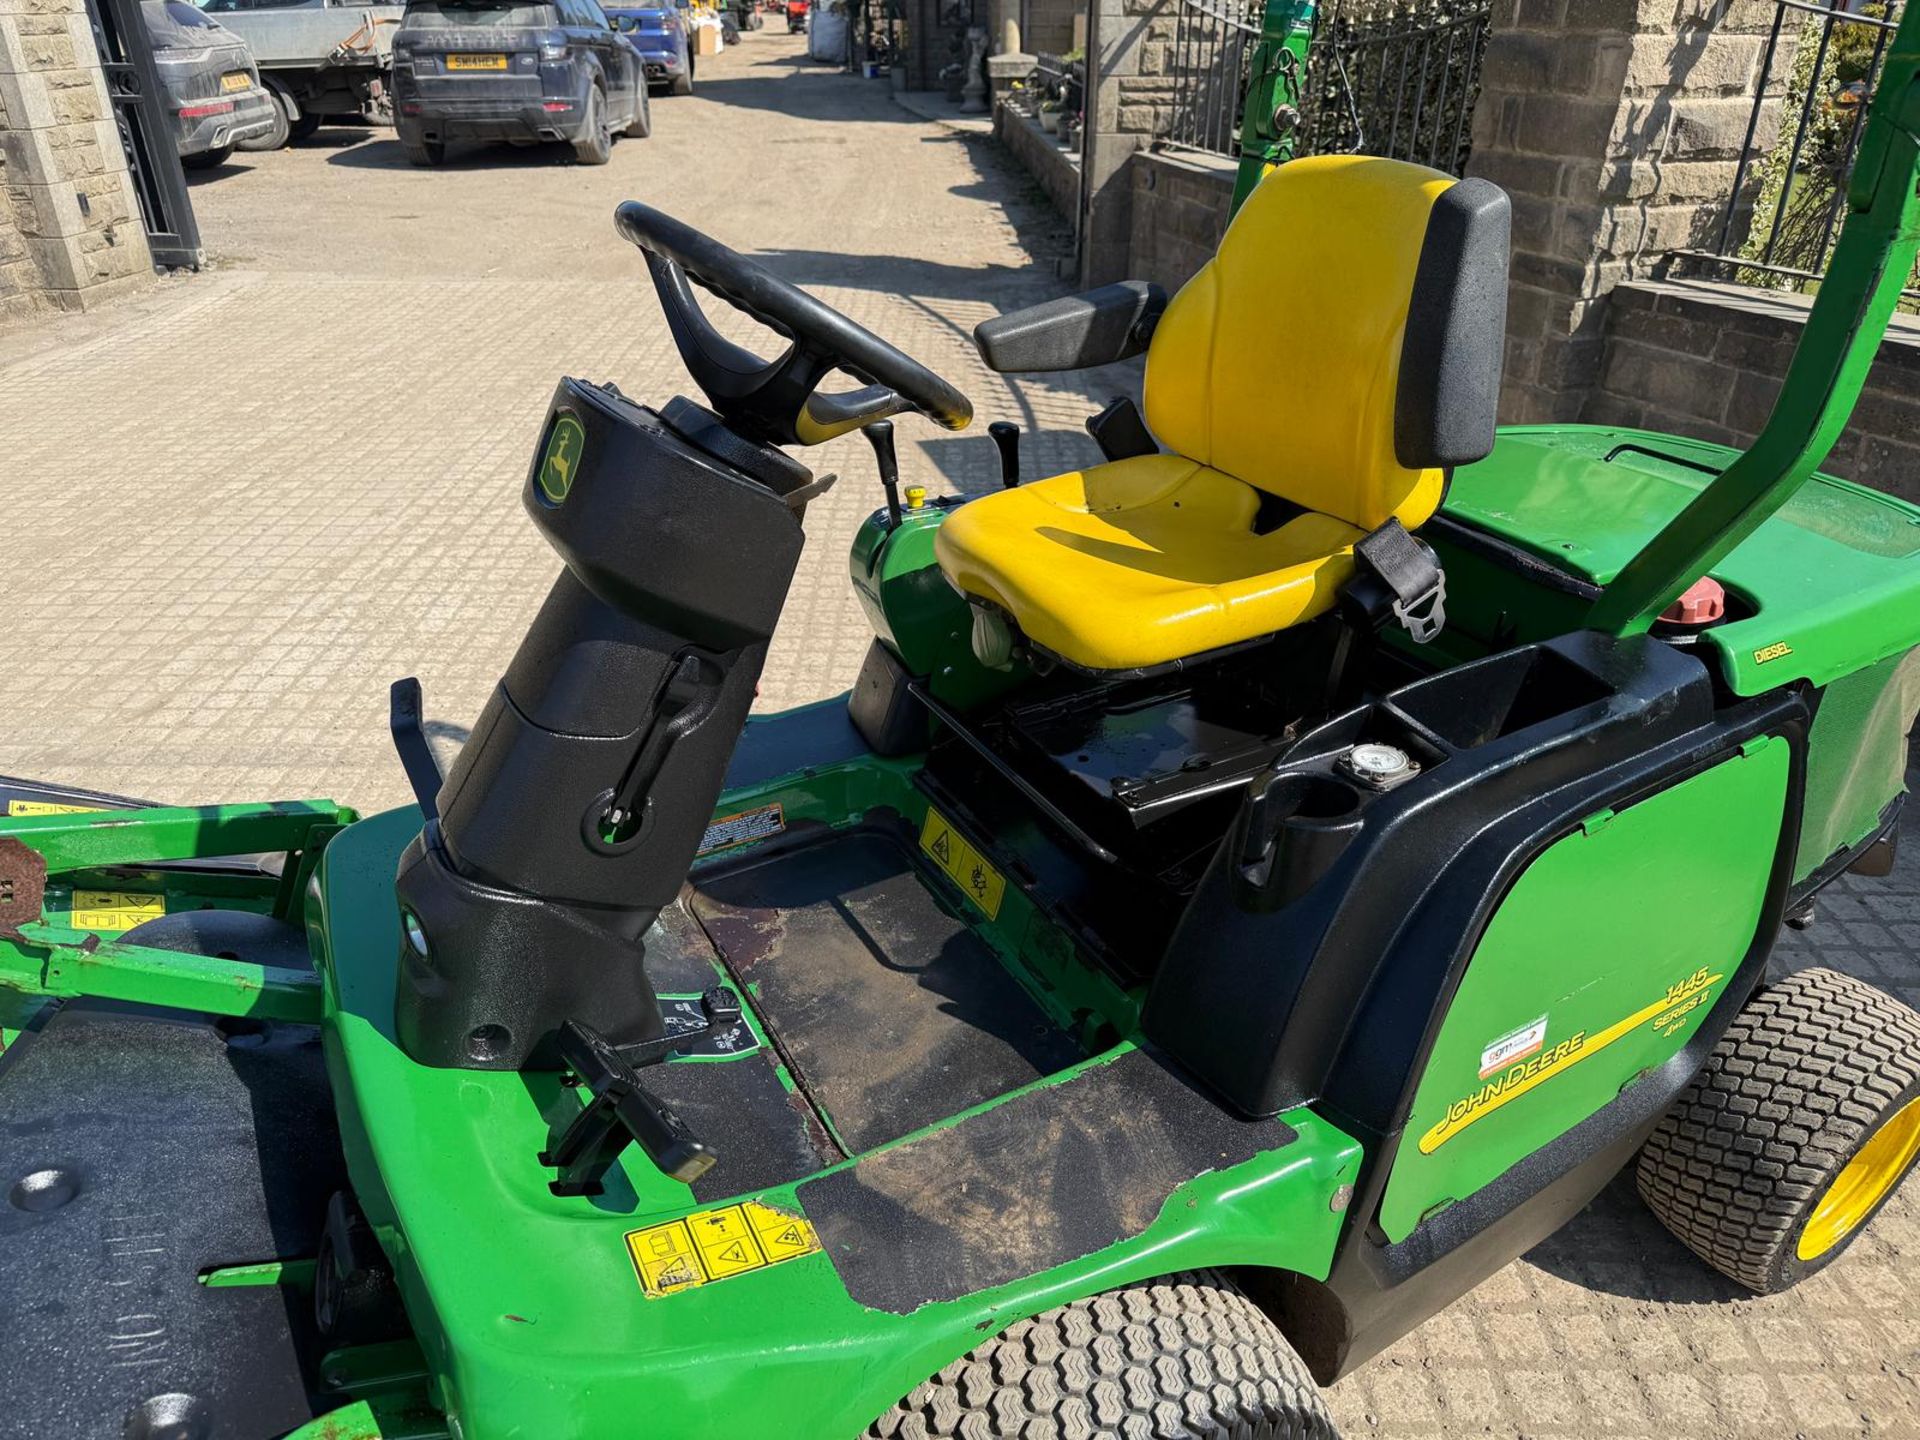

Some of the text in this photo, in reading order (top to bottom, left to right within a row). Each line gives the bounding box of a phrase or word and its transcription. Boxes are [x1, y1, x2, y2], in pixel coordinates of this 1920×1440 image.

[1753, 641, 1793, 665] DIESEL
[1665, 965, 1709, 1003] 1445
[1652, 997, 1699, 1031] SERIES
[1662, 1018, 1687, 1038] 4WD
[1436, 1076, 1505, 1134] JOHN
[1503, 1029, 1585, 1091] DEERE
